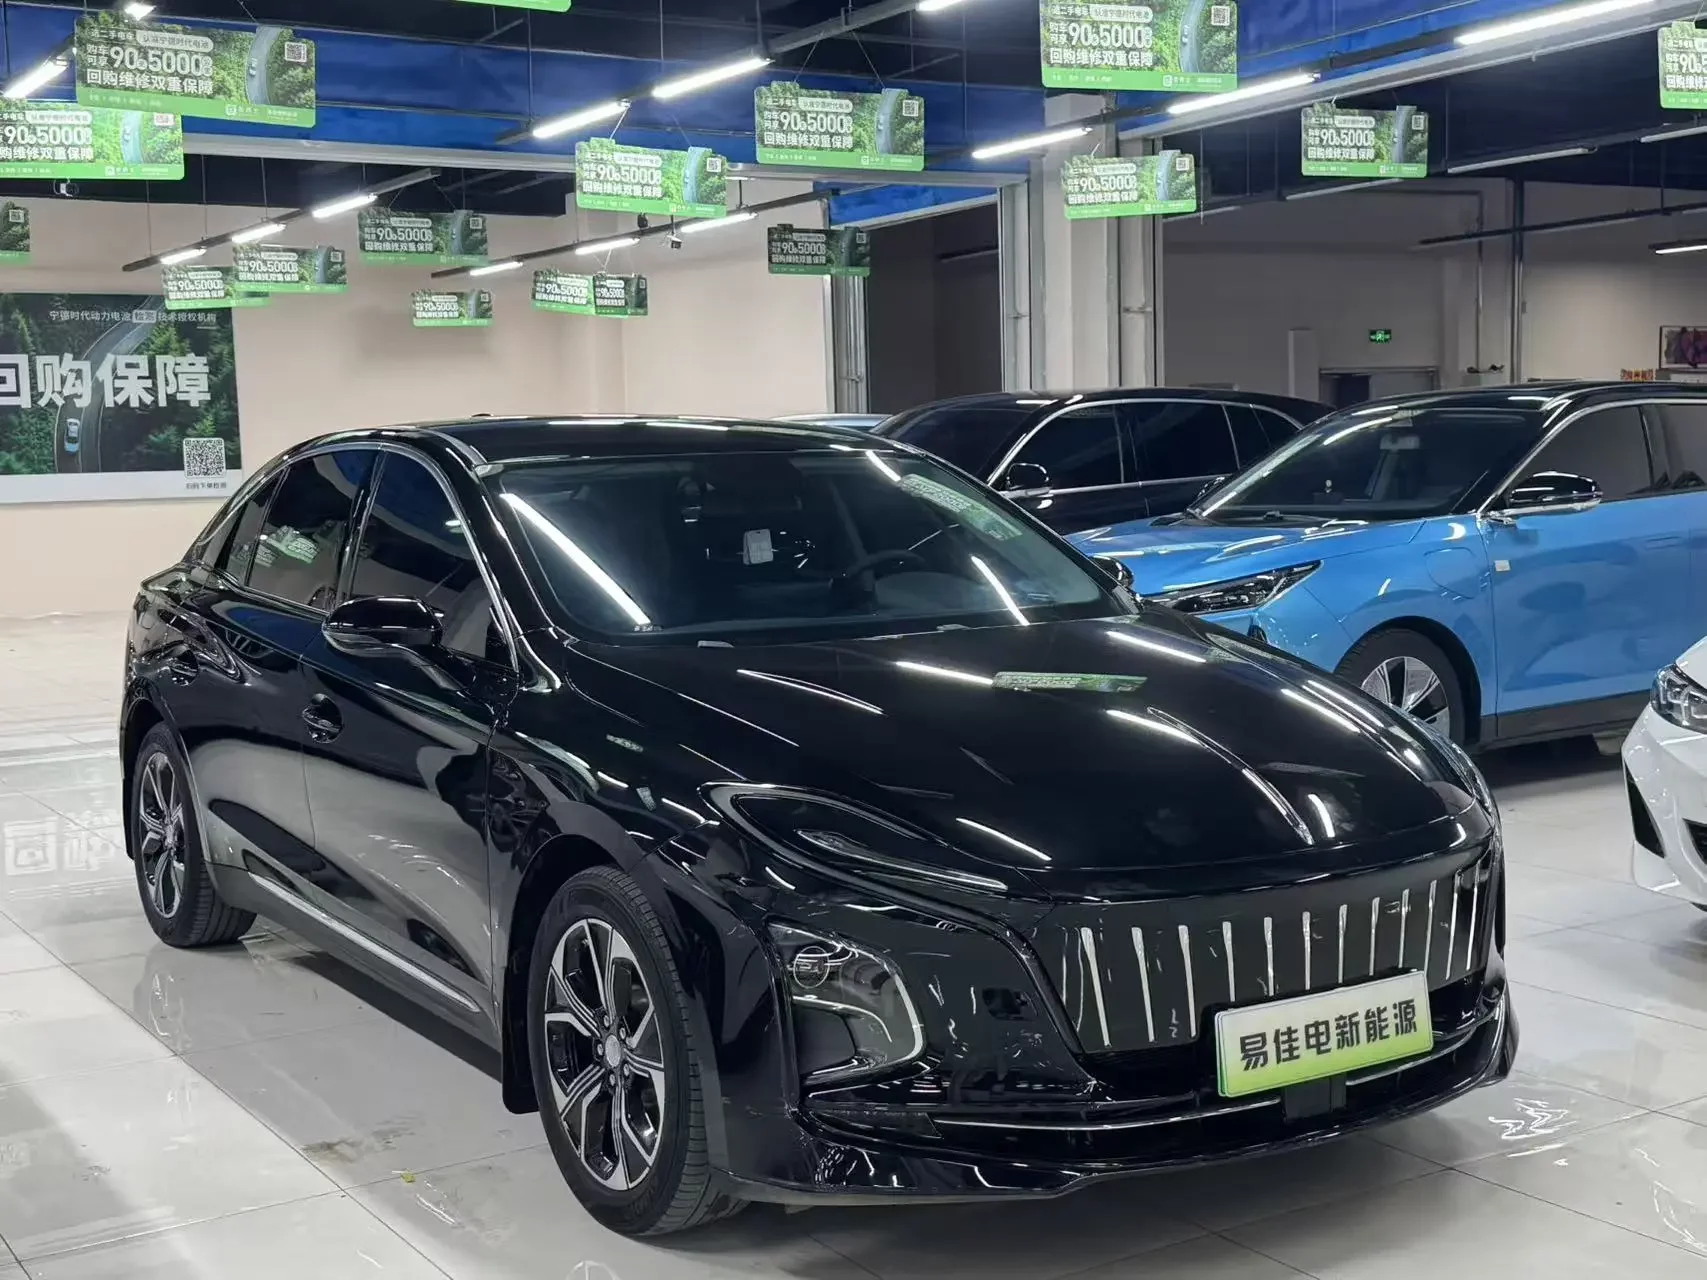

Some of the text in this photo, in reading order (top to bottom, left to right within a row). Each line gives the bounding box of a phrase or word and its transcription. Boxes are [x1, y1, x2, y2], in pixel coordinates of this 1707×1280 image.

[1050, 48, 1153, 67] 回购维修双重保障
[87, 68, 214, 95] 回购维修双重保障
[1239, 998, 1417, 1072] 易佳电新能源
